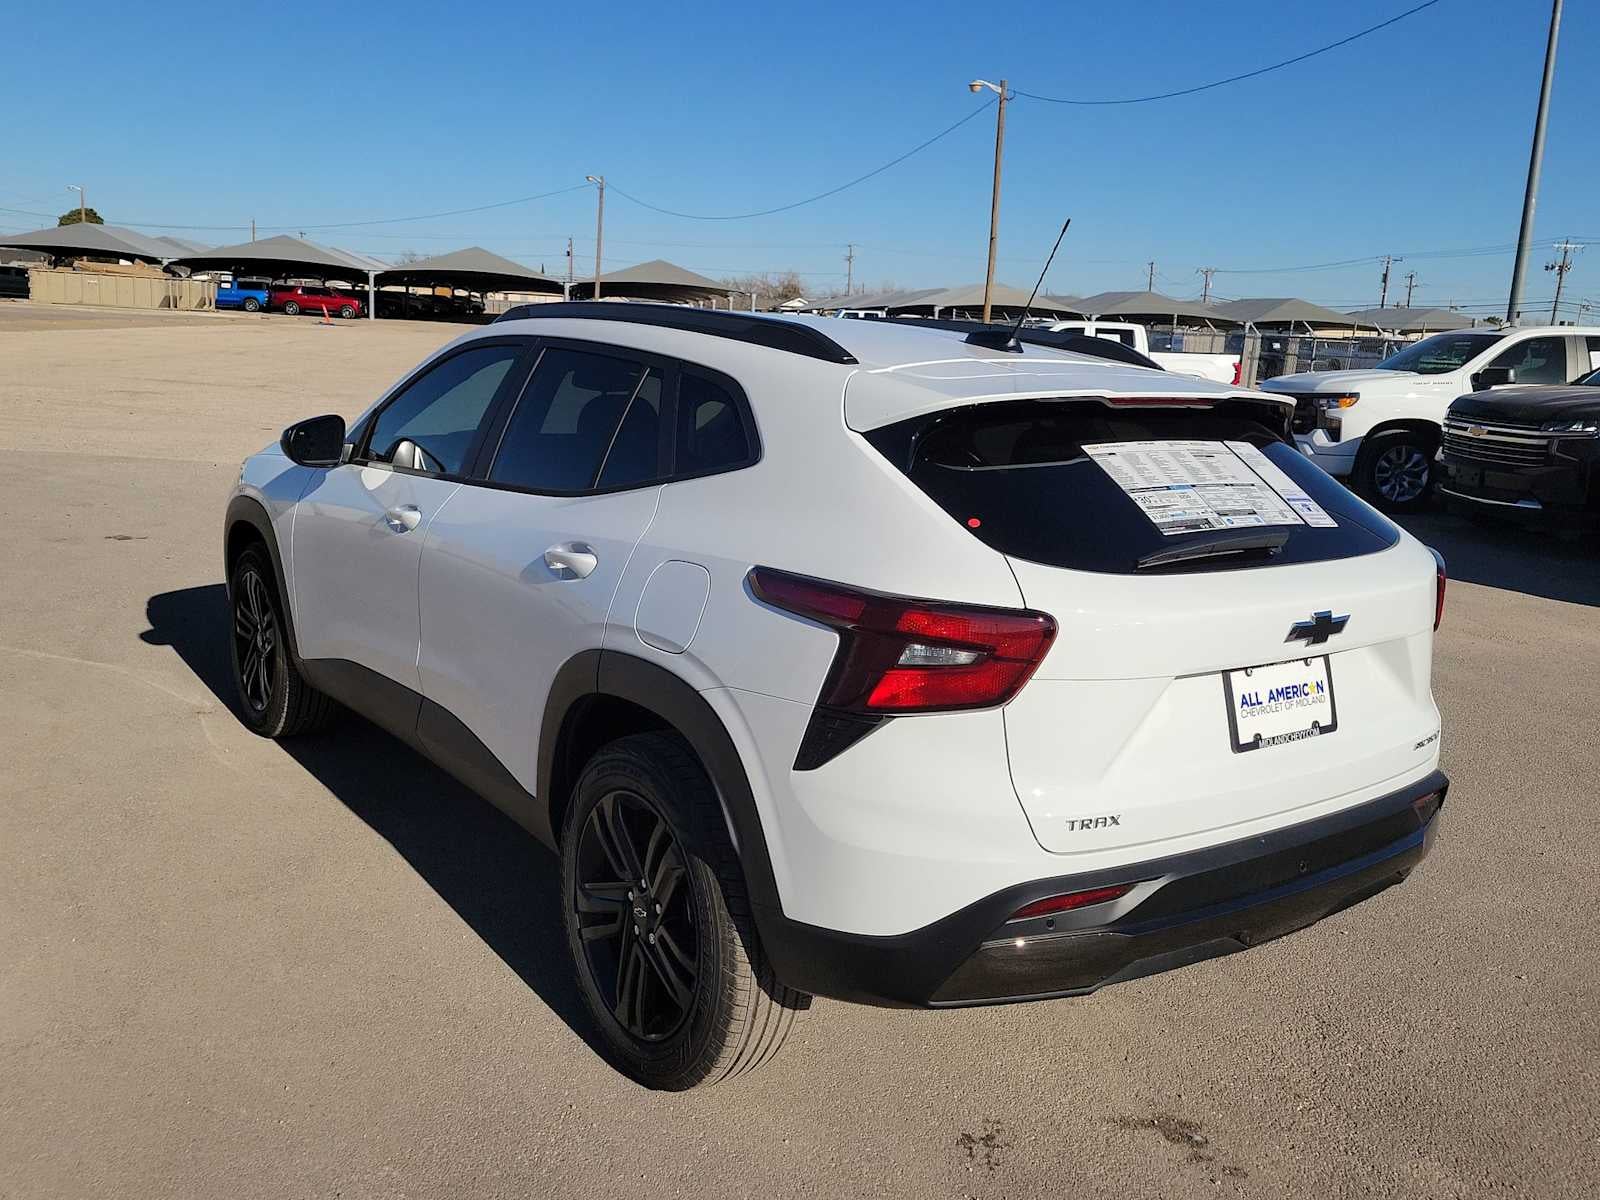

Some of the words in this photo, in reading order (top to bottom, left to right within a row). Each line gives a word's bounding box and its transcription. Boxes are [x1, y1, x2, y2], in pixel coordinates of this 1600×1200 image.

[1240, 691, 1263, 709] ALL
[1240, 702, 1283, 719] CHEVROLET
[1285, 700, 1295, 711] OF
[1295, 695, 1326, 709] MIDLAND
[1065, 814, 1121, 832] TRAX
